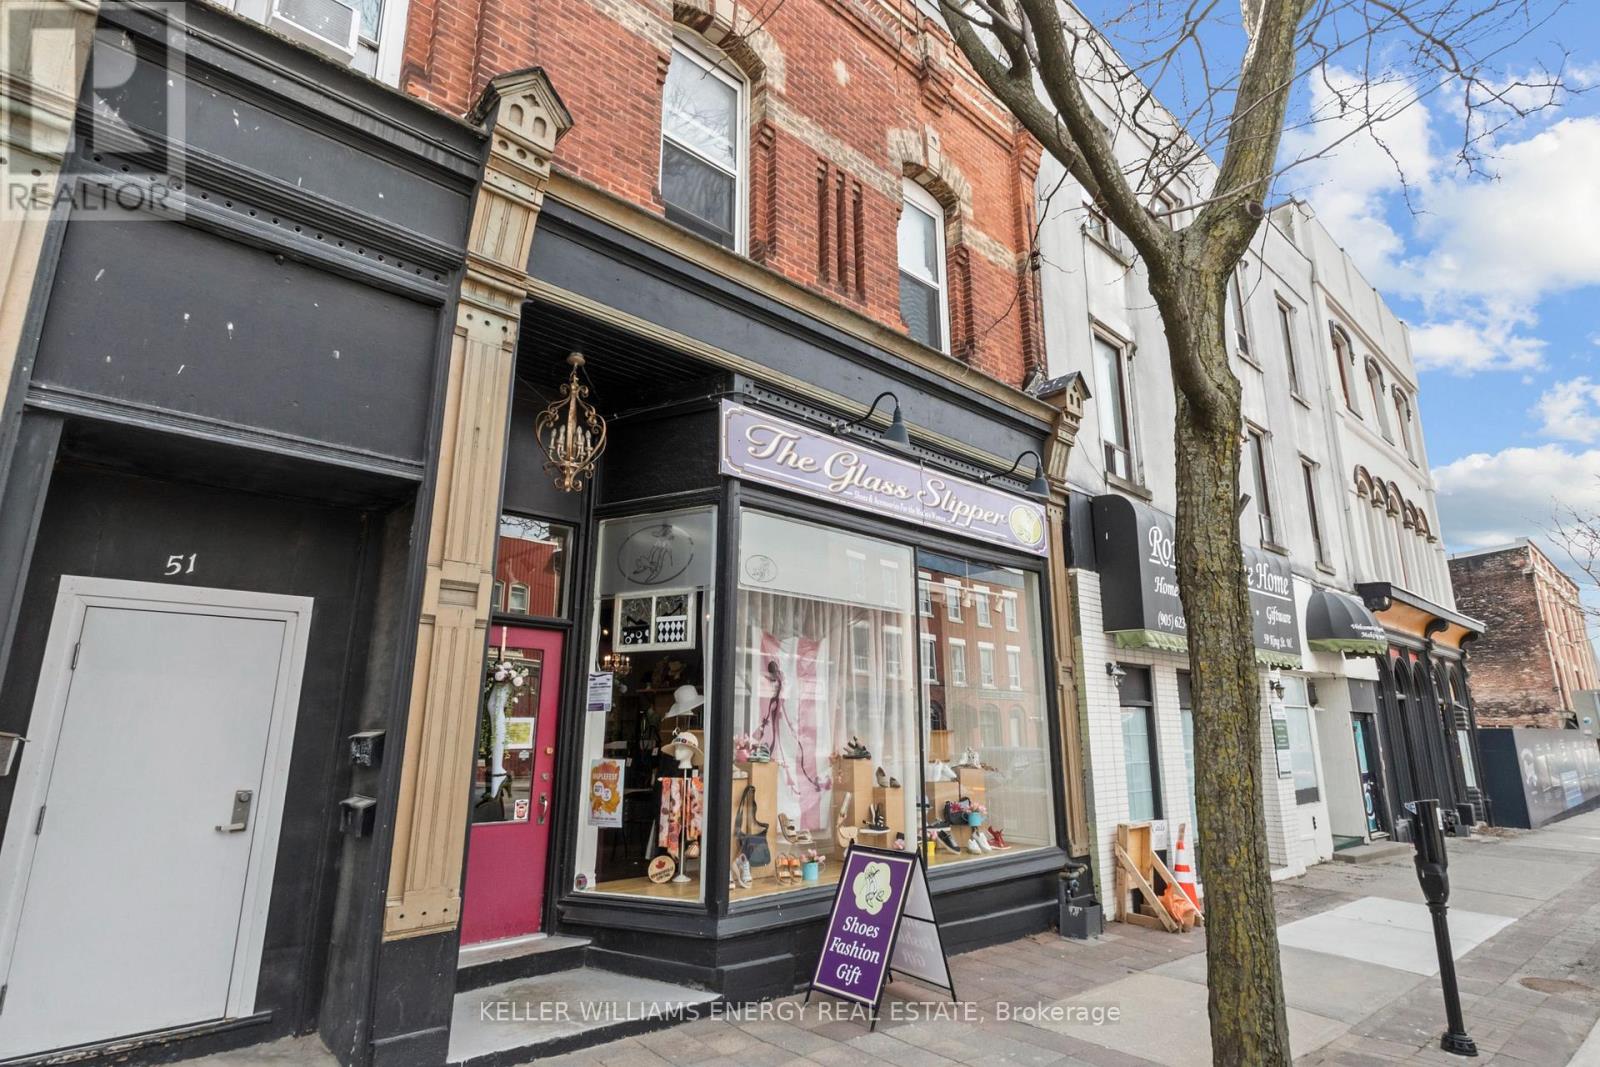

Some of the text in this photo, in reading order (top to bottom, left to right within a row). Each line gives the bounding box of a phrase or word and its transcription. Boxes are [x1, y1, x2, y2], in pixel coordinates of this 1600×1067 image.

[744, 424, 1009, 528] The Glass Slipper
[164, 553, 197, 575] 51
[1154, 576, 1180, 597] Home
[1256, 563, 1290, 596] Home
[1158, 611, 1174, 631] (905)
[842, 916, 880, 938] Shoes
[829, 937, 880, 964] Fashion
[836, 963, 862, 986] Gift
